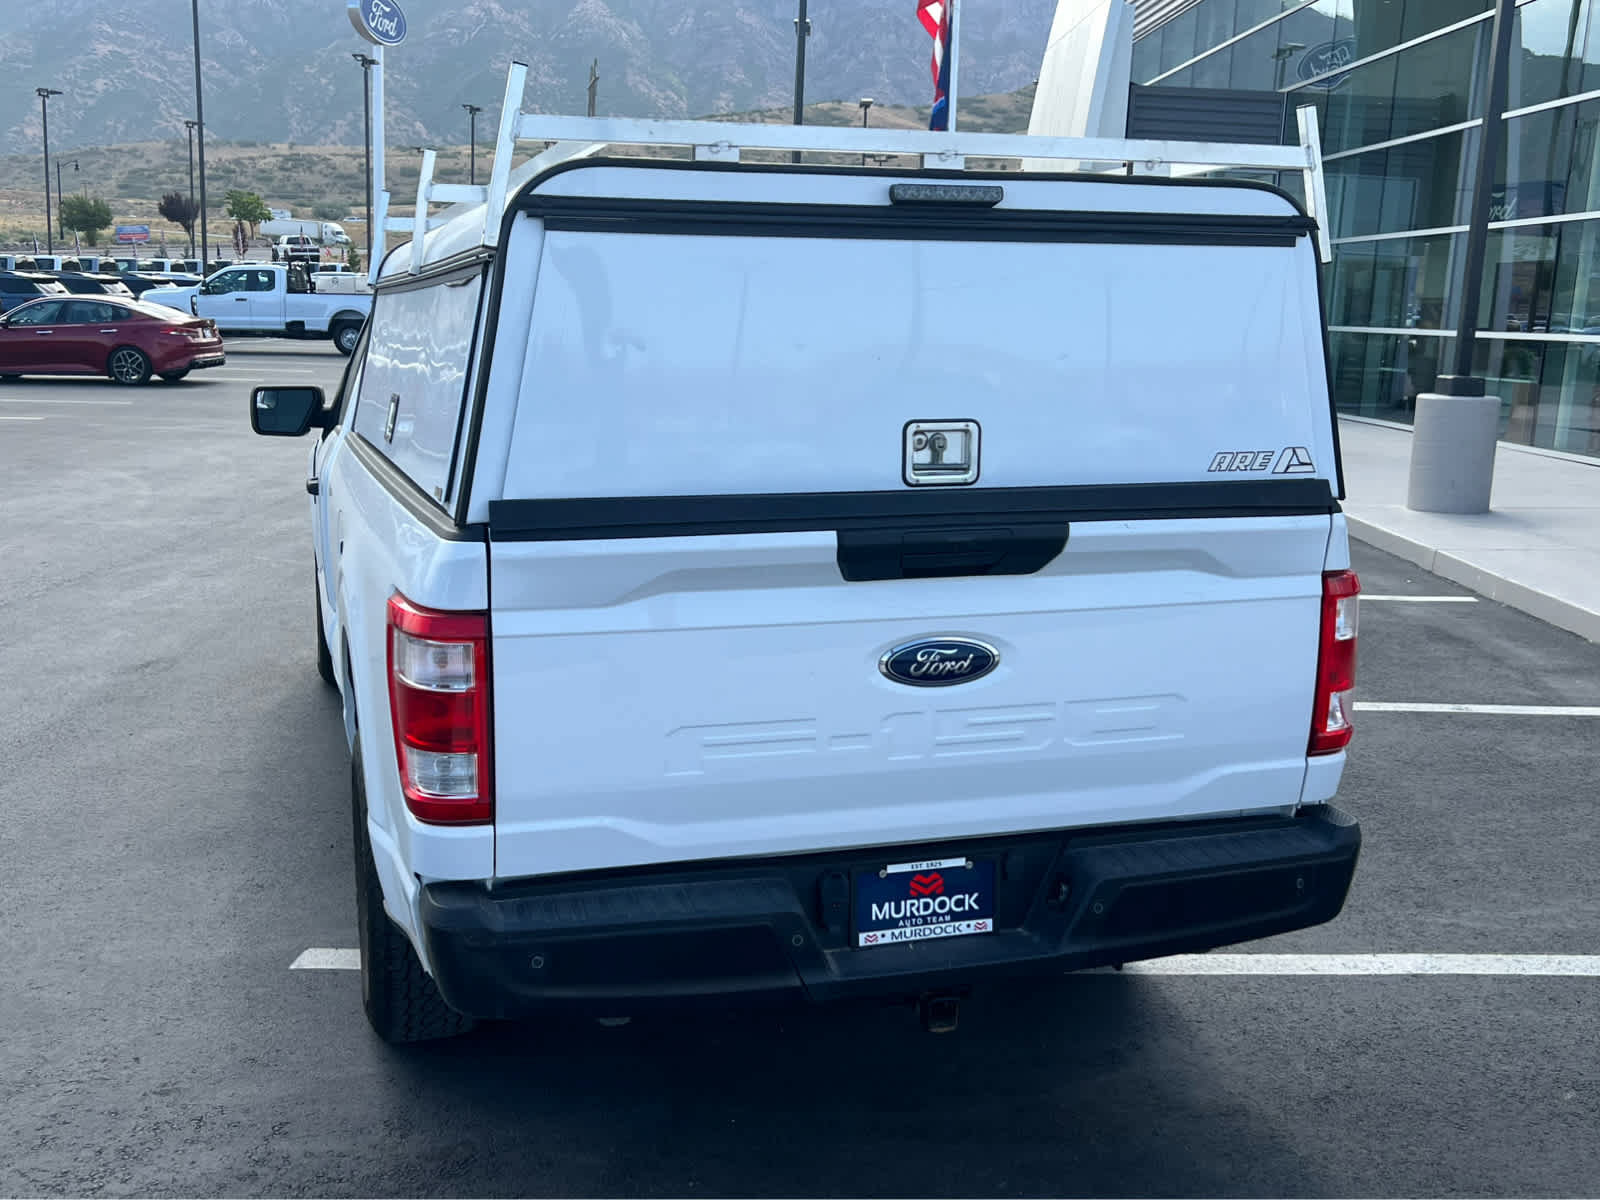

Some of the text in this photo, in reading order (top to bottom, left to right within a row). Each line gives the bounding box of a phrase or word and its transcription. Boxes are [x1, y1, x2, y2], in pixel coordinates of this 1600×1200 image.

[369, 0, 398, 37] Ford
[1207, 451, 1275, 472] ARE
[910, 648, 974, 676] Ford
[664, 693, 1188, 777] F-150
[871, 892, 980, 921] MURDOCK
[890, 923, 963, 941] MURDOCK
[898, 915, 951, 927] AUTO TEAM
